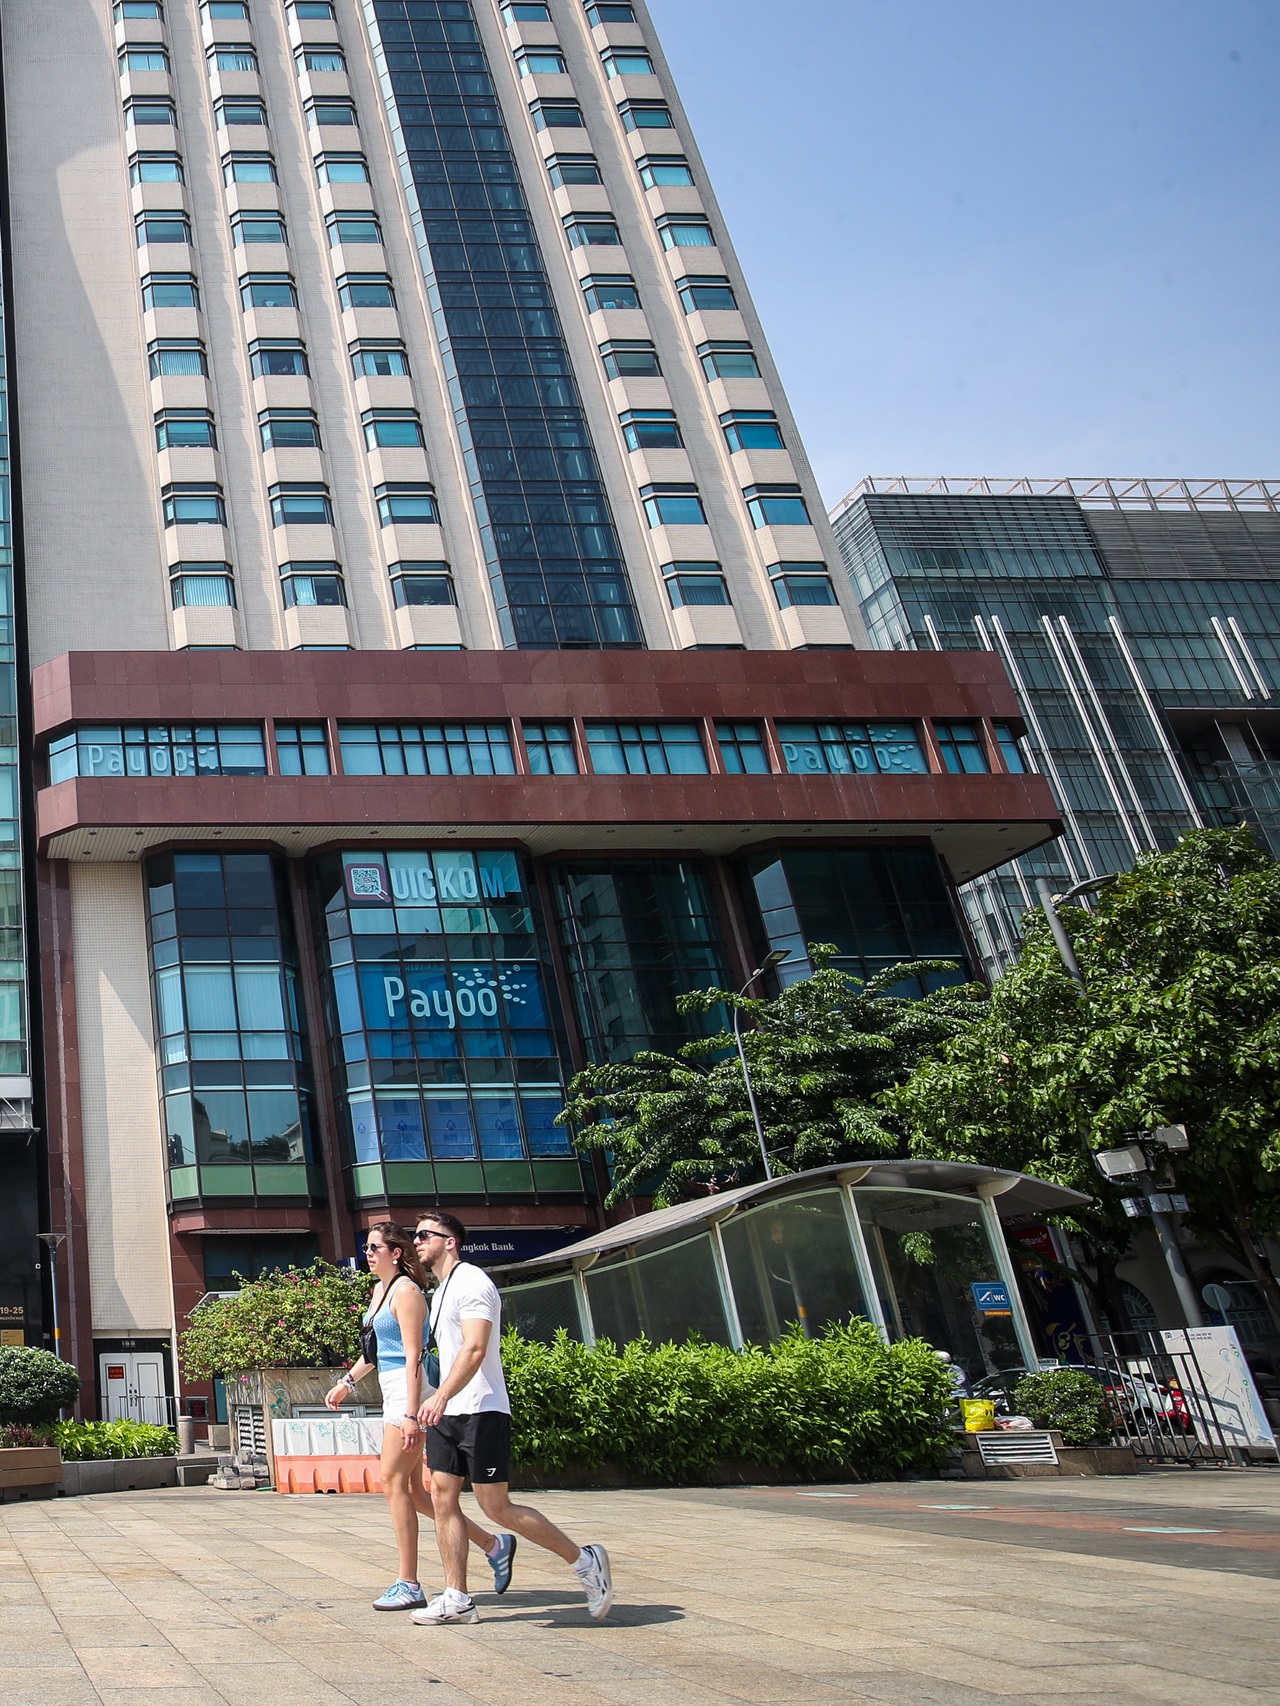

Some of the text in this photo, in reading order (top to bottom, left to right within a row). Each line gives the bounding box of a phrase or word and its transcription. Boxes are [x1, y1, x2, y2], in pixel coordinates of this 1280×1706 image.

[87, 744, 189, 777] Payoo
[781, 743, 891, 773] Payoo
[383, 976, 498, 1029] Payoo
[491, 1242, 515, 1251] Bank
[0, 1306, 24, 1315] 19-25
